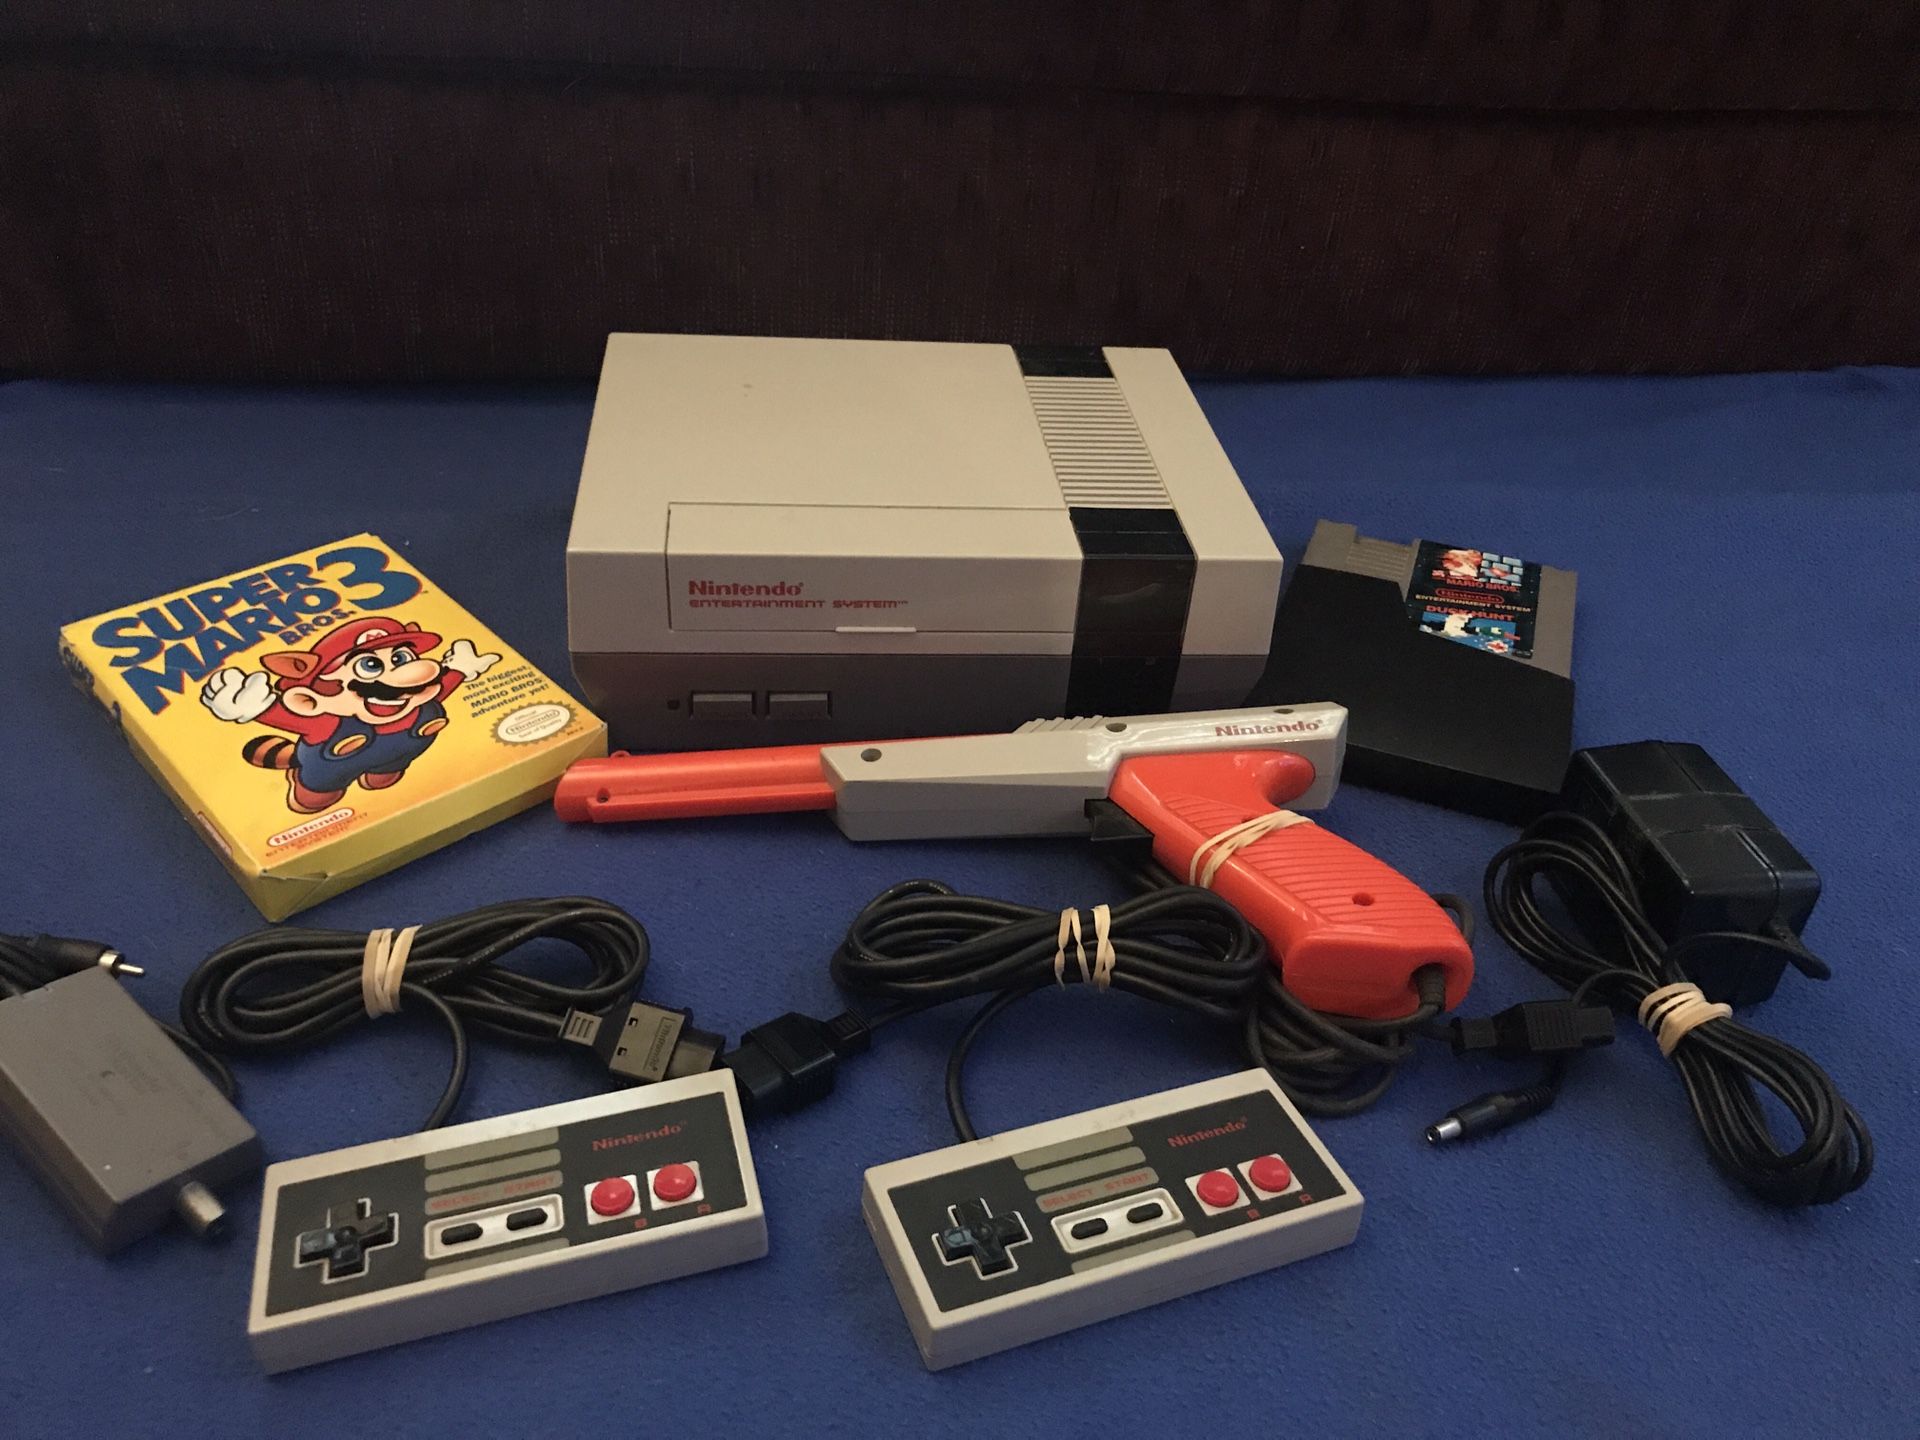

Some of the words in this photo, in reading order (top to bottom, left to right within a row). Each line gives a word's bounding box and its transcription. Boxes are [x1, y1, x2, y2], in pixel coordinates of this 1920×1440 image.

[688, 580, 803, 597] Nintendo
[1446, 578, 1484, 589] MARIO
[92, 563, 326, 668] SUPER
[315, 546, 422, 611] 3
[689, 599, 826, 609] ENTERTAINMENT
[1415, 594, 1492, 608] ENTERTAINMENT
[1495, 603, 1532, 613] SYSTEM
[1471, 610, 1515, 621] HUNT
[121, 587, 341, 715] MARIO
[462, 687, 490, 702] most
[492, 671, 535, 690] exciting
[465, 680, 486, 691] The
[471, 690, 509, 709] MARIO
[471, 693, 527, 718] adventure
[1214, 719, 1321, 736] Nintendo
[273, 811, 349, 844] Nintendo
[592, 1123, 683, 1150] Nintendo
[1167, 1119, 1246, 1148] Nintendo
[1104, 1173, 1149, 1191] START
